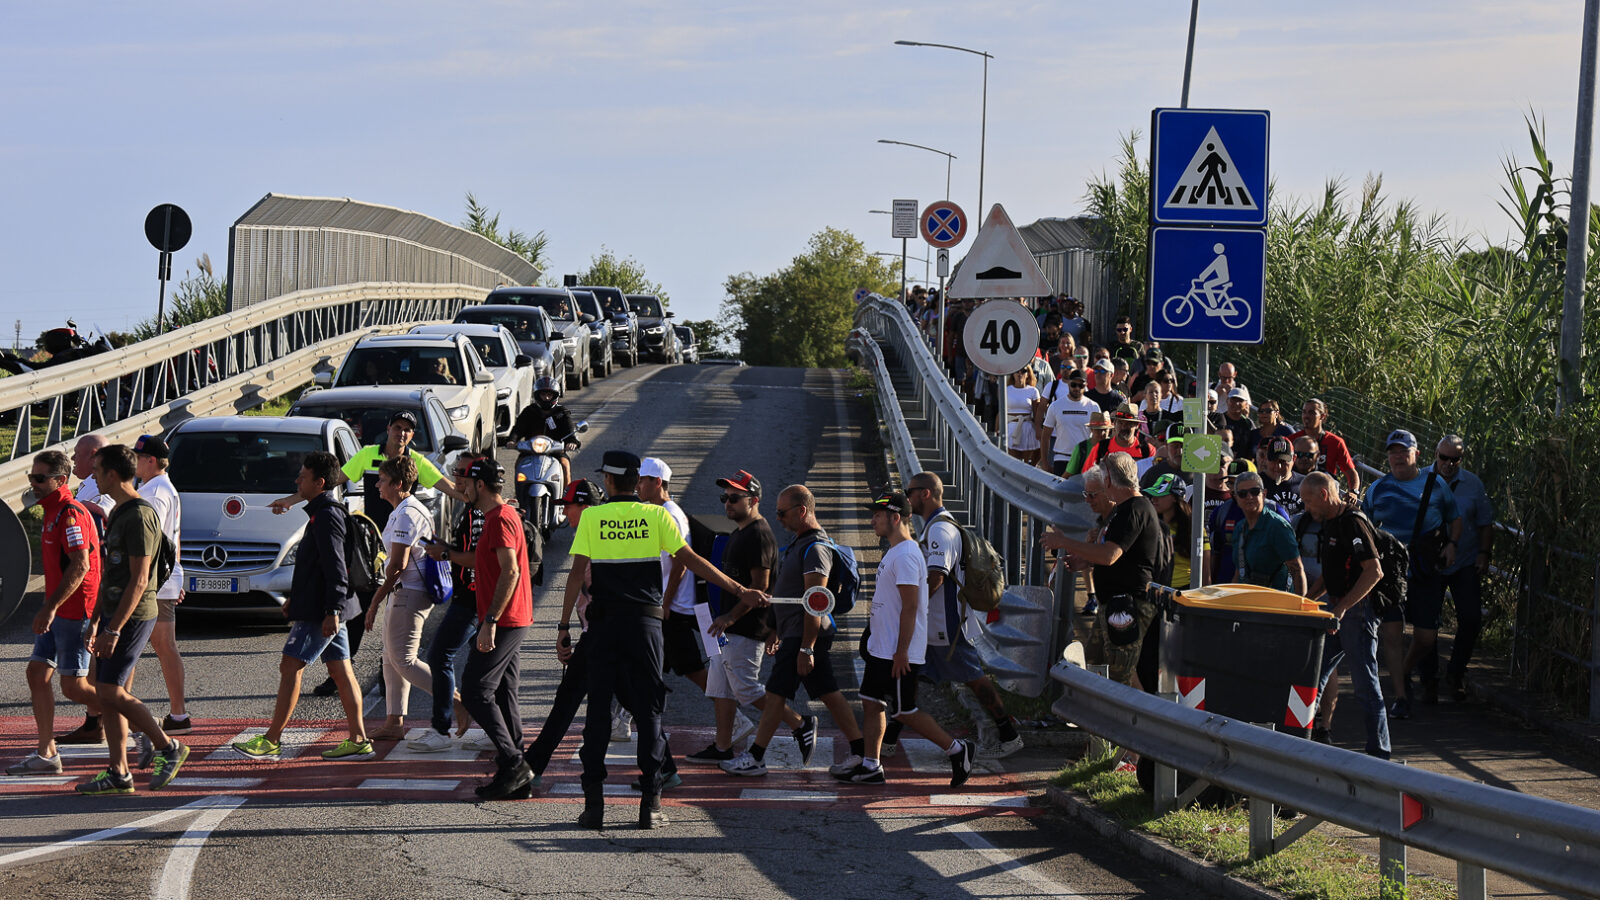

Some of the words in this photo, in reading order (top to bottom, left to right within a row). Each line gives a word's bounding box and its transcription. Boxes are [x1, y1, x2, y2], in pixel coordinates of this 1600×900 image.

[980, 319, 1021, 355] 40
[600, 518, 649, 530] POLIZIA
[600, 530, 649, 540] LOCALE
